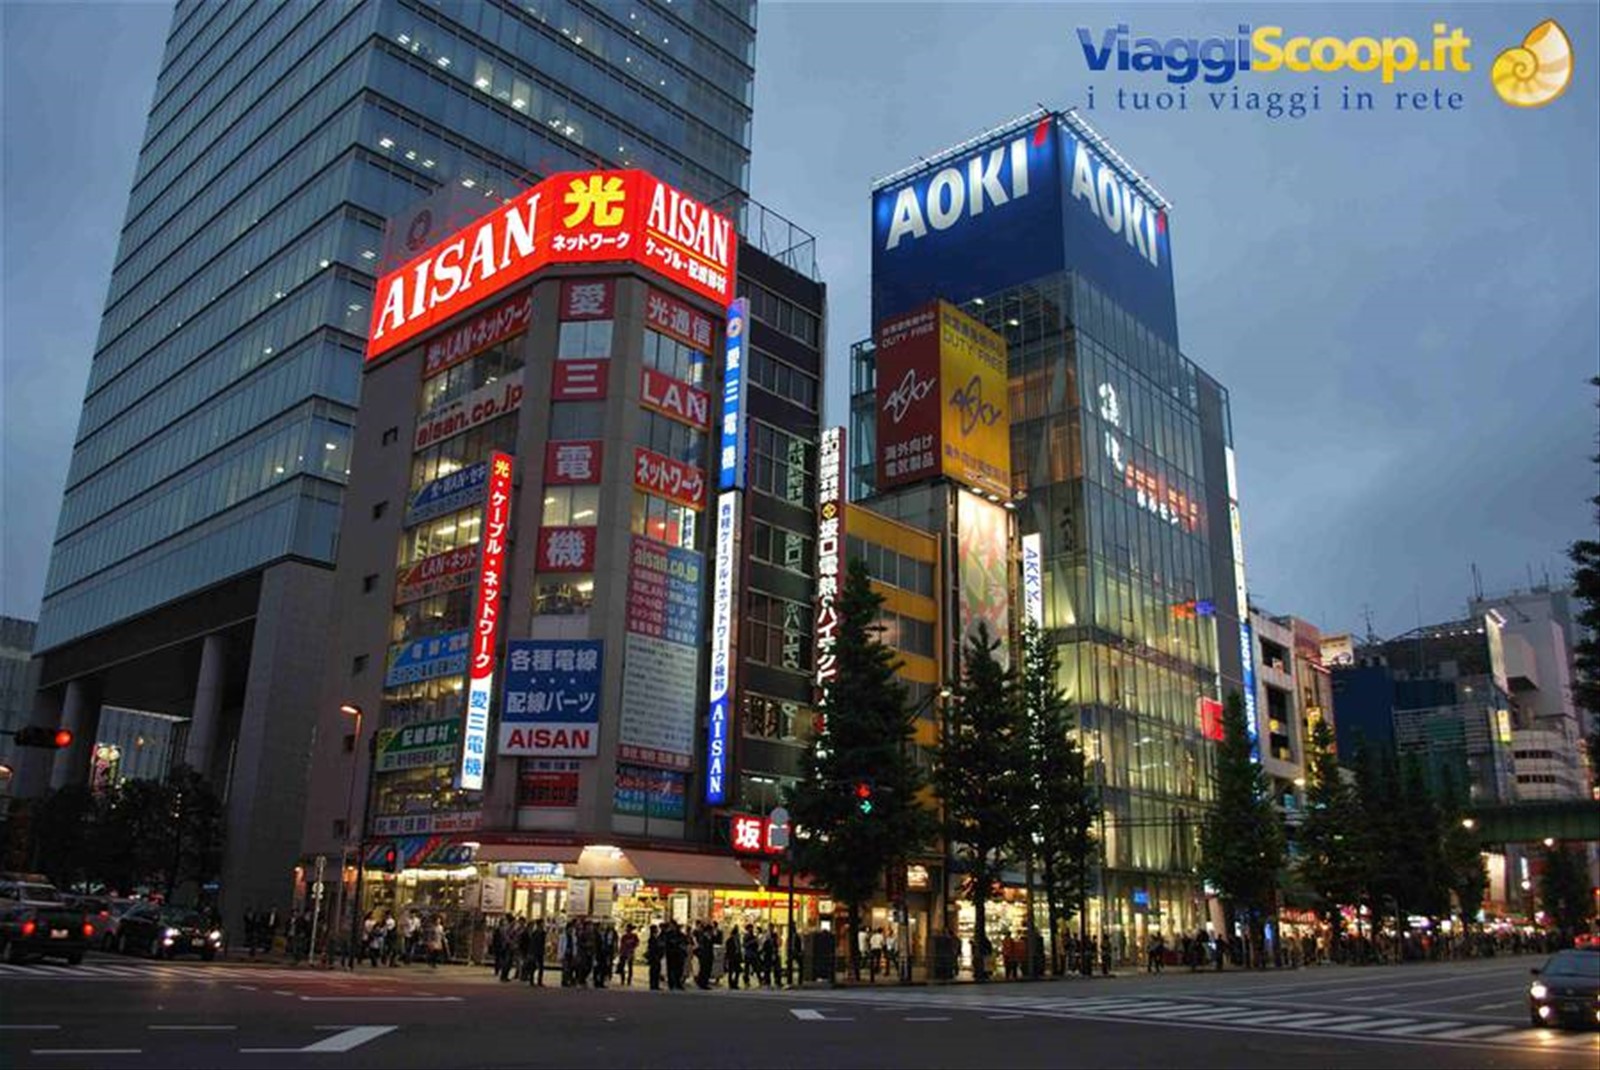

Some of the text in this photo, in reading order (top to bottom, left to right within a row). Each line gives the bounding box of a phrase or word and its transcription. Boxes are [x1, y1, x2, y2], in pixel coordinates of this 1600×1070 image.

[564, 175, 626, 229] 光
[885, 137, 1030, 251] AOKI
[1071, 140, 1159, 268] AOKI
[552, 231, 631, 252] ネットワーク
[647, 183, 731, 267] AISAN
[373, 193, 541, 340] AISAN
[648, 295, 712, 347] 光通信
[642, 377, 708, 423] LAN
[637, 455, 703, 502] ネットワーク
[510, 649, 599, 672] 各種電線
[506, 691, 596, 714] 配線パーツ
[506, 729, 590, 750] AISAN
[709, 703, 724, 794] AISAN
